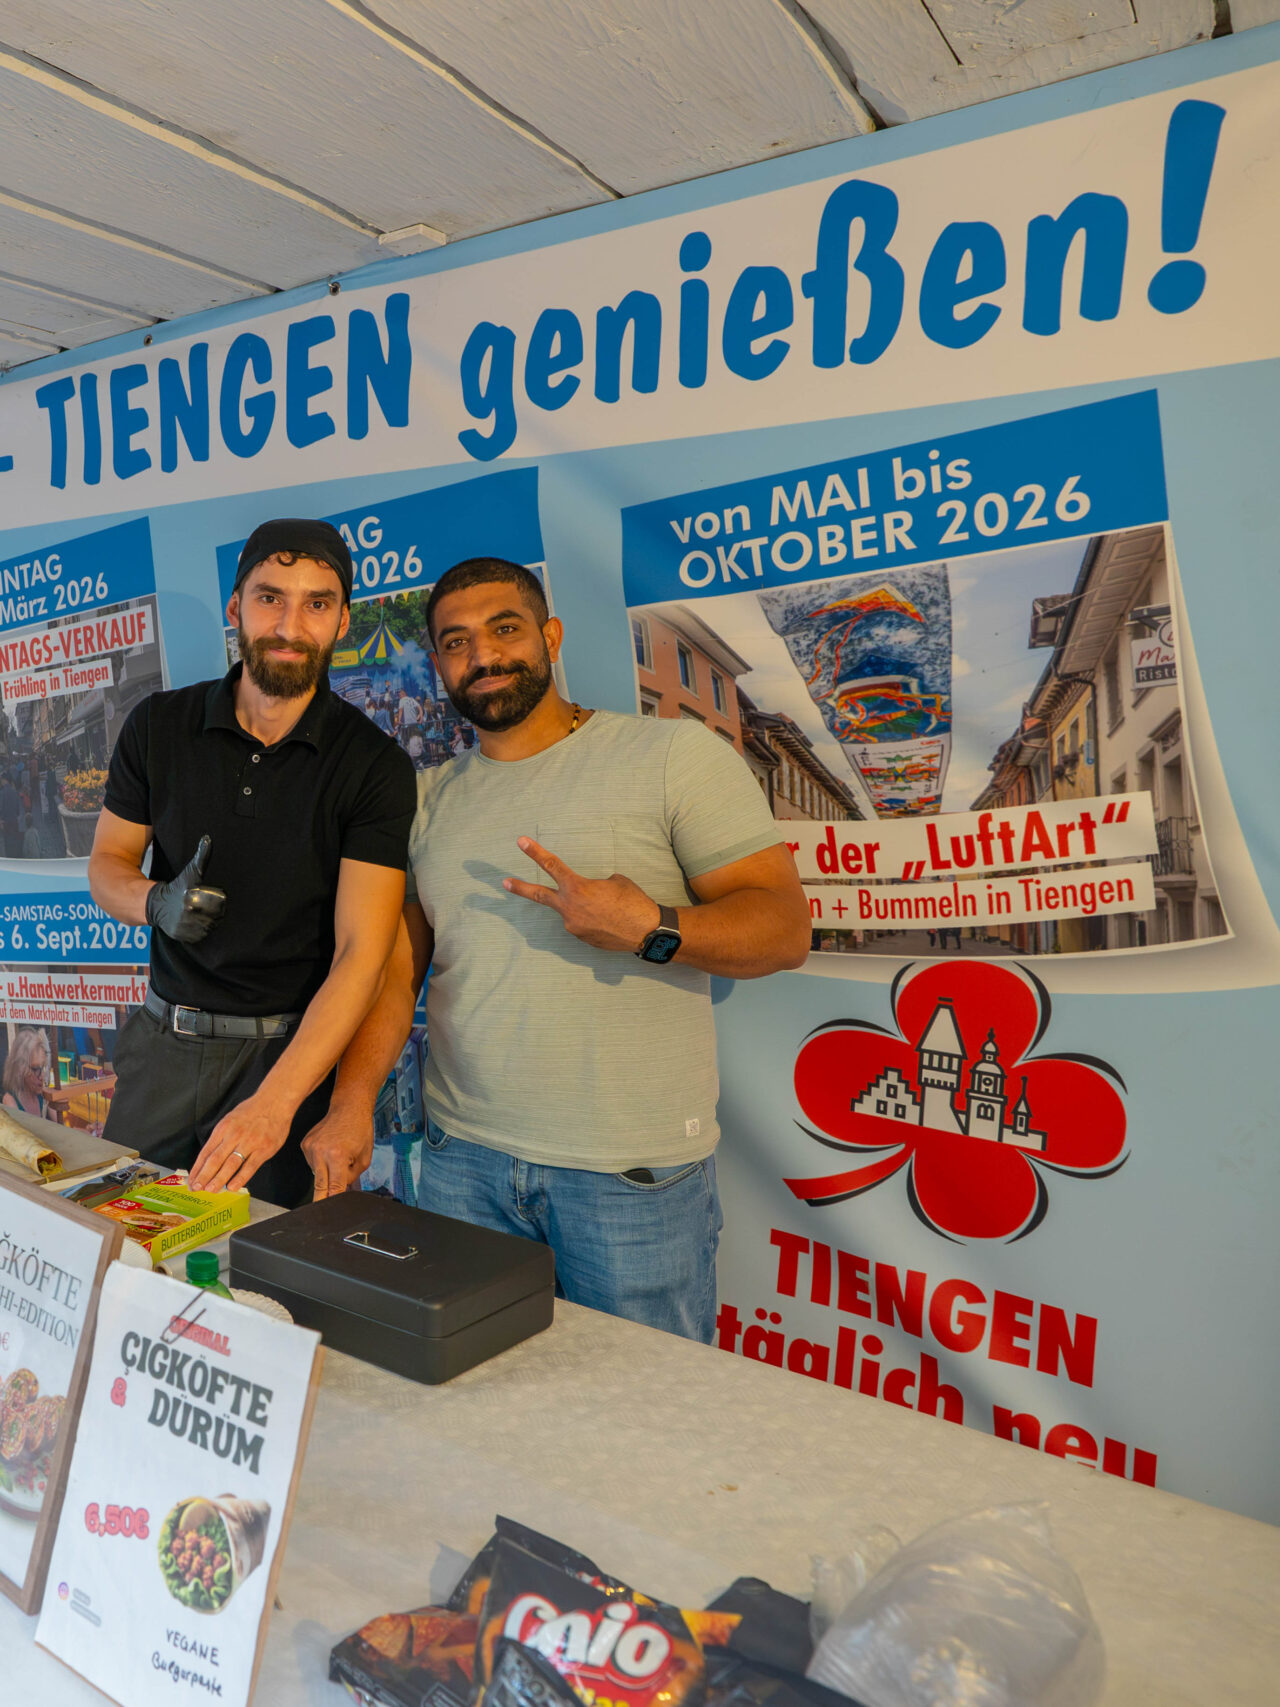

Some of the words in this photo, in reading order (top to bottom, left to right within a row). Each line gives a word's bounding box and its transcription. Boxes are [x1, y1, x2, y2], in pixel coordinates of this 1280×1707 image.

[35, 293, 412, 489] TIENGEN
[458, 99, 1227, 461] genießen!
[670, 502, 751, 545] von
[769, 468, 871, 527] MAI
[893, 449, 973, 501] bis
[678, 511, 917, 589] OKTOBER
[935, 475, 1092, 545] 2026
[53, 572, 109, 611] 2026
[3, 672, 47, 700] Frühling
[50, 672, 60, 691] in
[62, 665, 109, 690] Tiengen
[816, 826, 880, 875] der
[901, 800, 1130, 882] „LuftArt“
[858, 882, 977, 921] Bummeln
[987, 880, 1011, 916] in
[1018, 878, 1135, 915] Tiengen
[11, 925, 29, 949] 6.
[9, 1003, 26, 1020] dem
[28, 1005, 69, 1025] Marktplatz
[71, 1007, 79, 1022] in
[80, 1007, 113, 1028] Tiengen
[161, 1208, 233, 1251] BUTTERBROTTÜTEN
[770, 1228, 1098, 1389] TIENGEN
[716, 1303, 964, 1426] täglich
[992, 1404, 1158, 1488] neu
[147, 1388, 265, 1475] DÜRÜM
[84, 1502, 150, 1540] 6,50€
[166, 1628, 220, 1667] VEGANE
